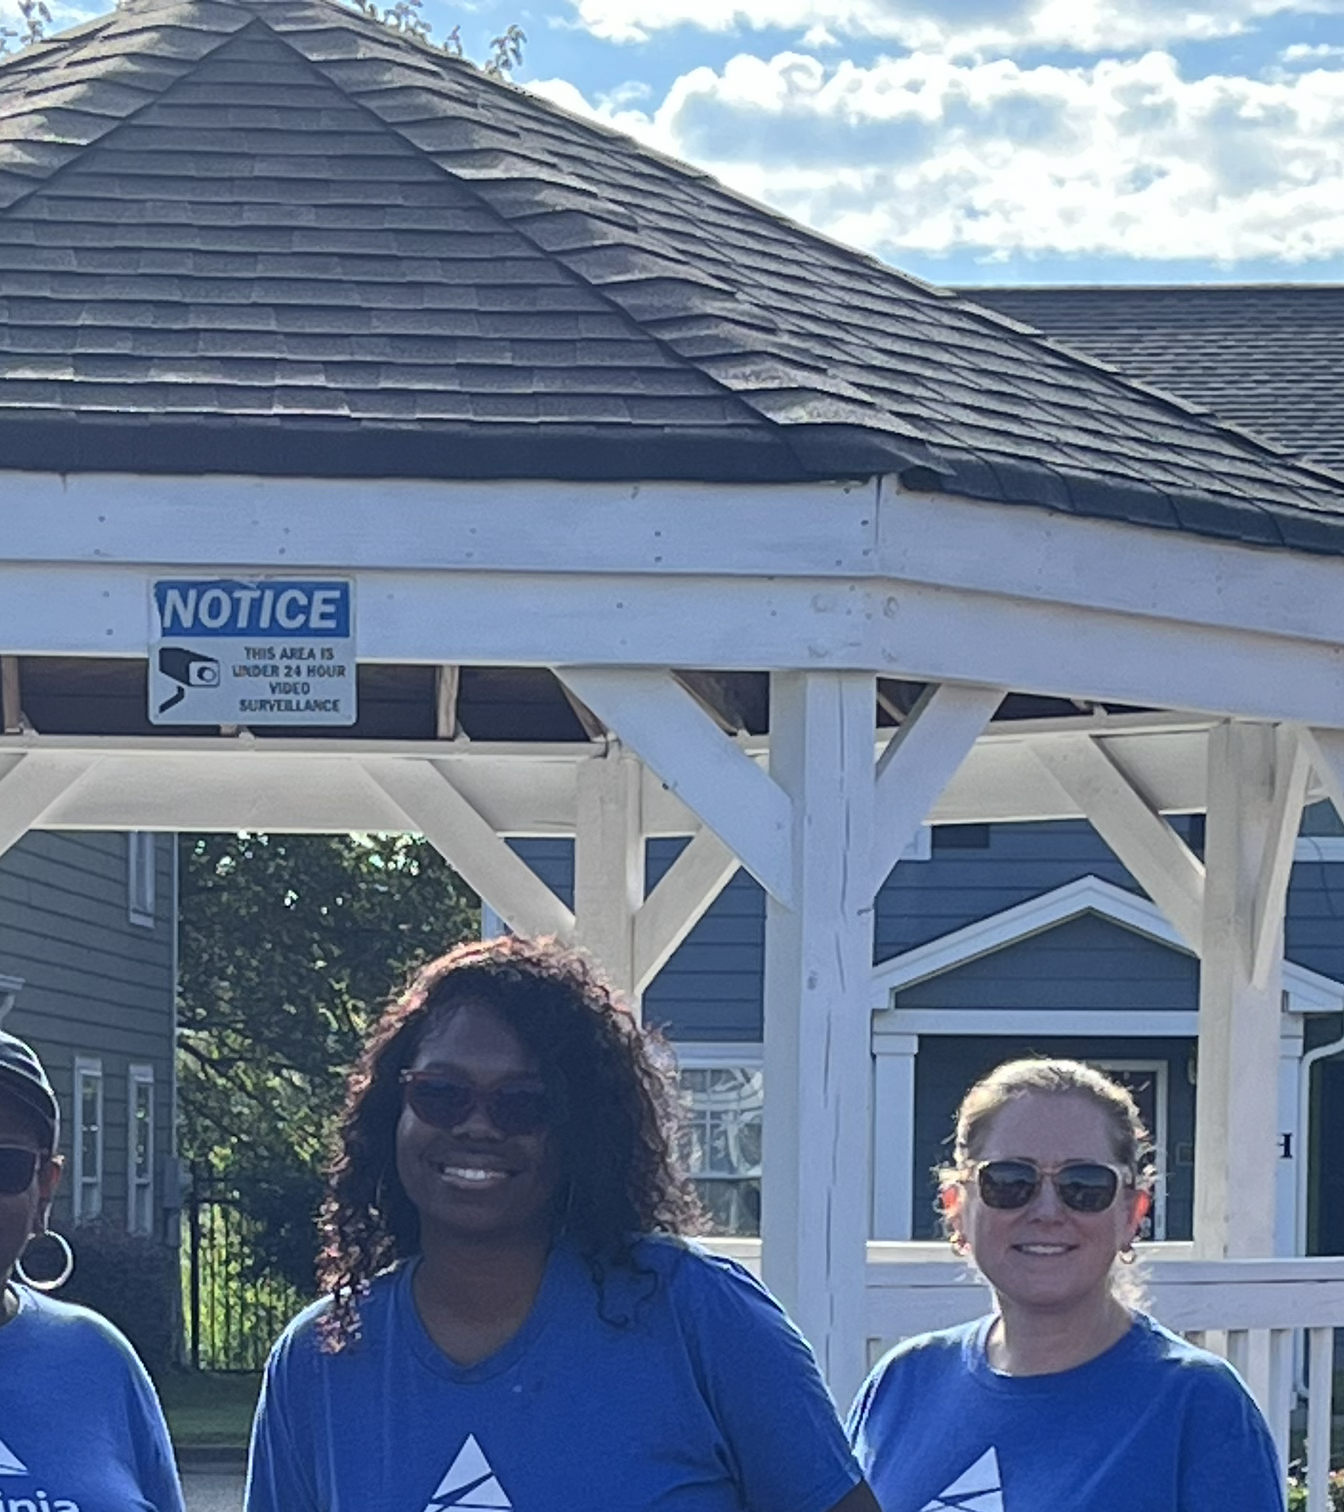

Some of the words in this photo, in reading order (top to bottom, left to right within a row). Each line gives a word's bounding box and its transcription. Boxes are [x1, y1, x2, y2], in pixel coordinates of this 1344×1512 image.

[163, 588, 341, 629] NOTICE
[244, 646, 276, 660] THIS
[280, 646, 315, 660] AREA
[320, 646, 335, 660] IS
[232, 664, 278, 678] UNDER
[284, 664, 302, 678] 24
[307, 664, 346, 678] HOUR
[269, 681, 310, 695] VIDEO
[239, 700, 341, 713] SURVEILLANCE
